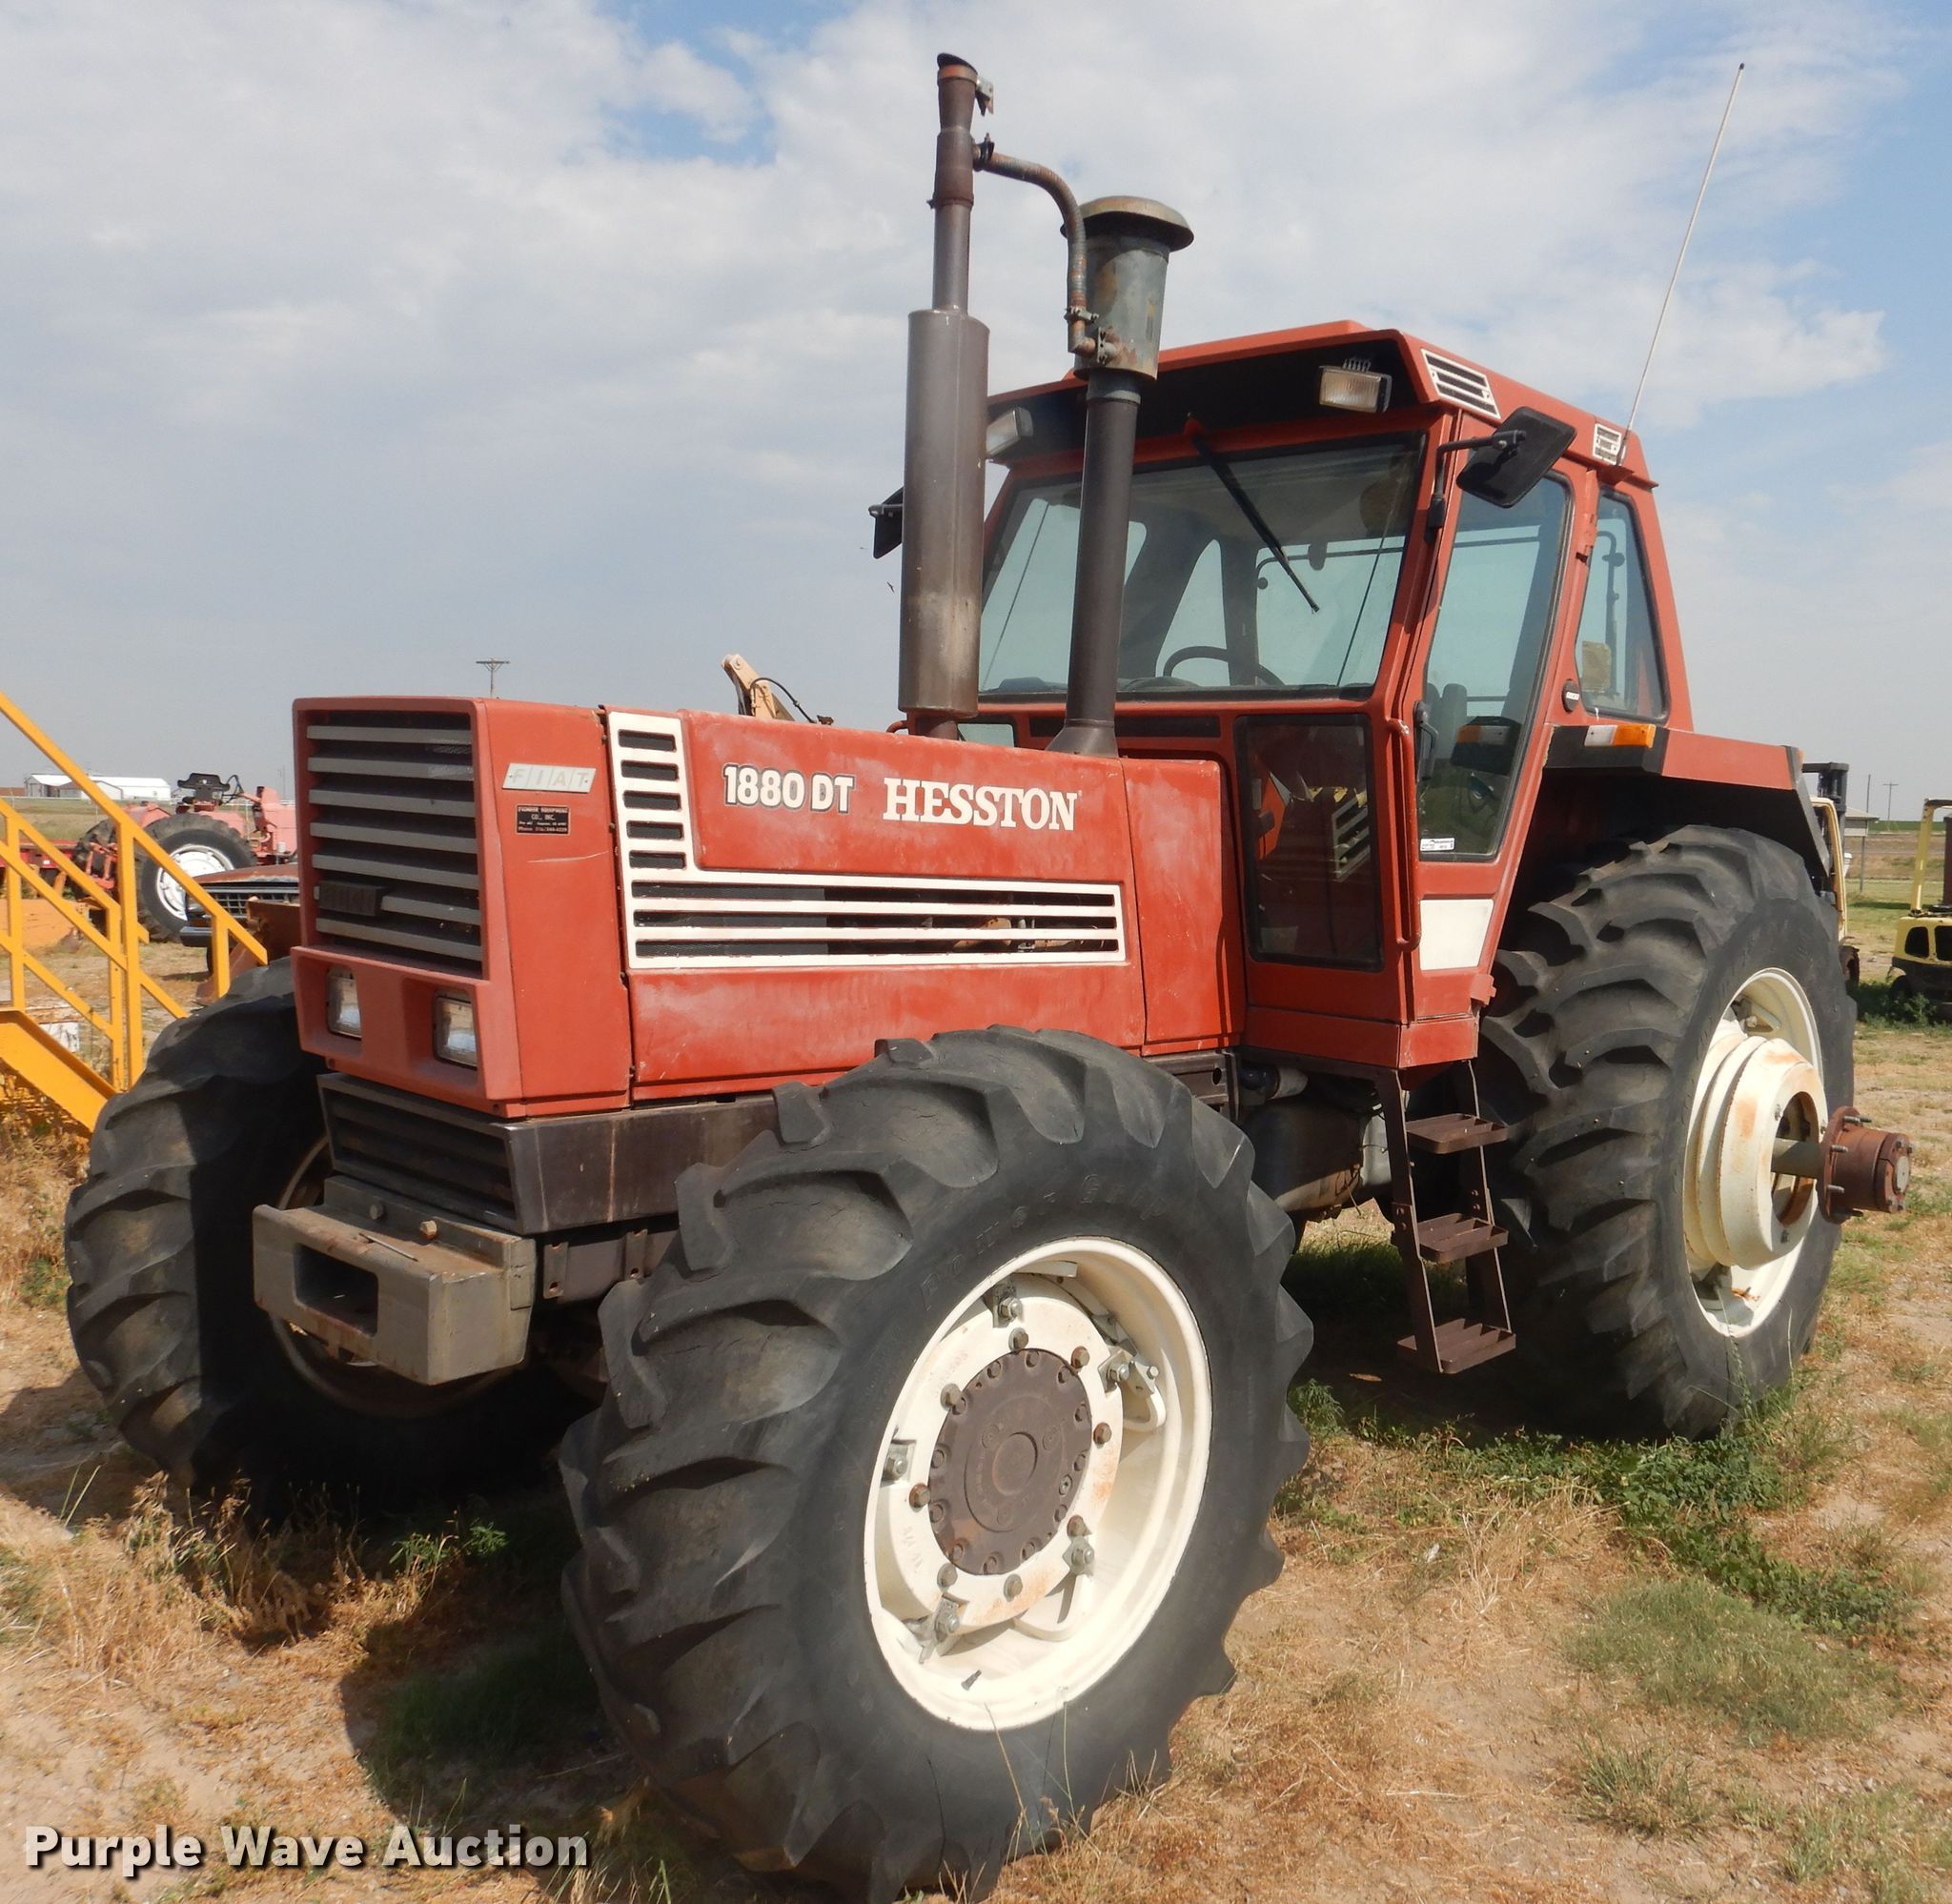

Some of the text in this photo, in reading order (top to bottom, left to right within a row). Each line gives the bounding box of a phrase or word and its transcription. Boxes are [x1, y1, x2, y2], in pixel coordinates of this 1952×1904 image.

[511, 767, 590, 788] FIAT
[722, 763, 854, 814] 1880 DT
[883, 777, 1078, 831] HESSTON
